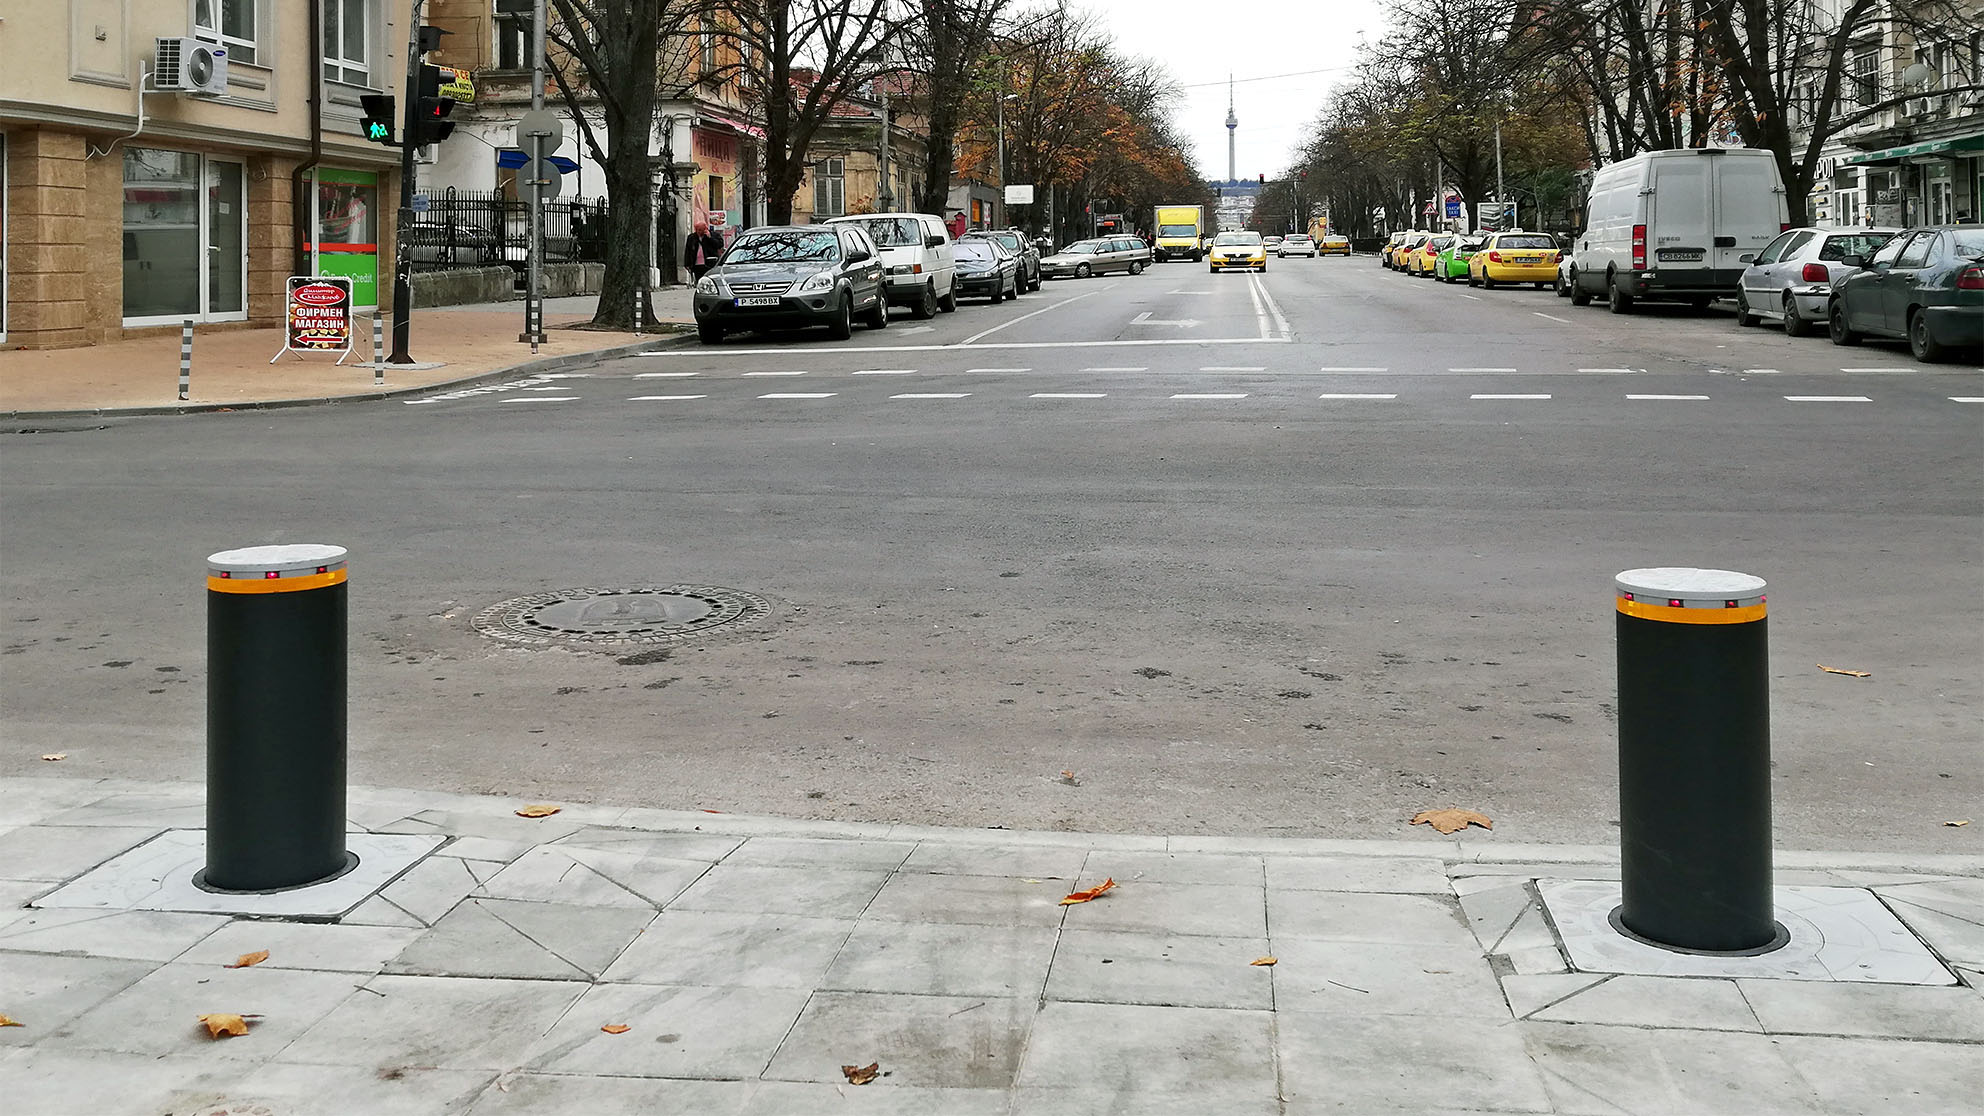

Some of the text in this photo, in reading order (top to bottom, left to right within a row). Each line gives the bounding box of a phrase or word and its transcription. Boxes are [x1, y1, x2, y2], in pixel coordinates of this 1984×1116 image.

[699, 136, 730, 162] ПИЦА
[351, 272, 373, 283] Credit
[296, 308, 343, 317] ФИРМЕН
[295, 319, 344, 329] МАГАЗИН
